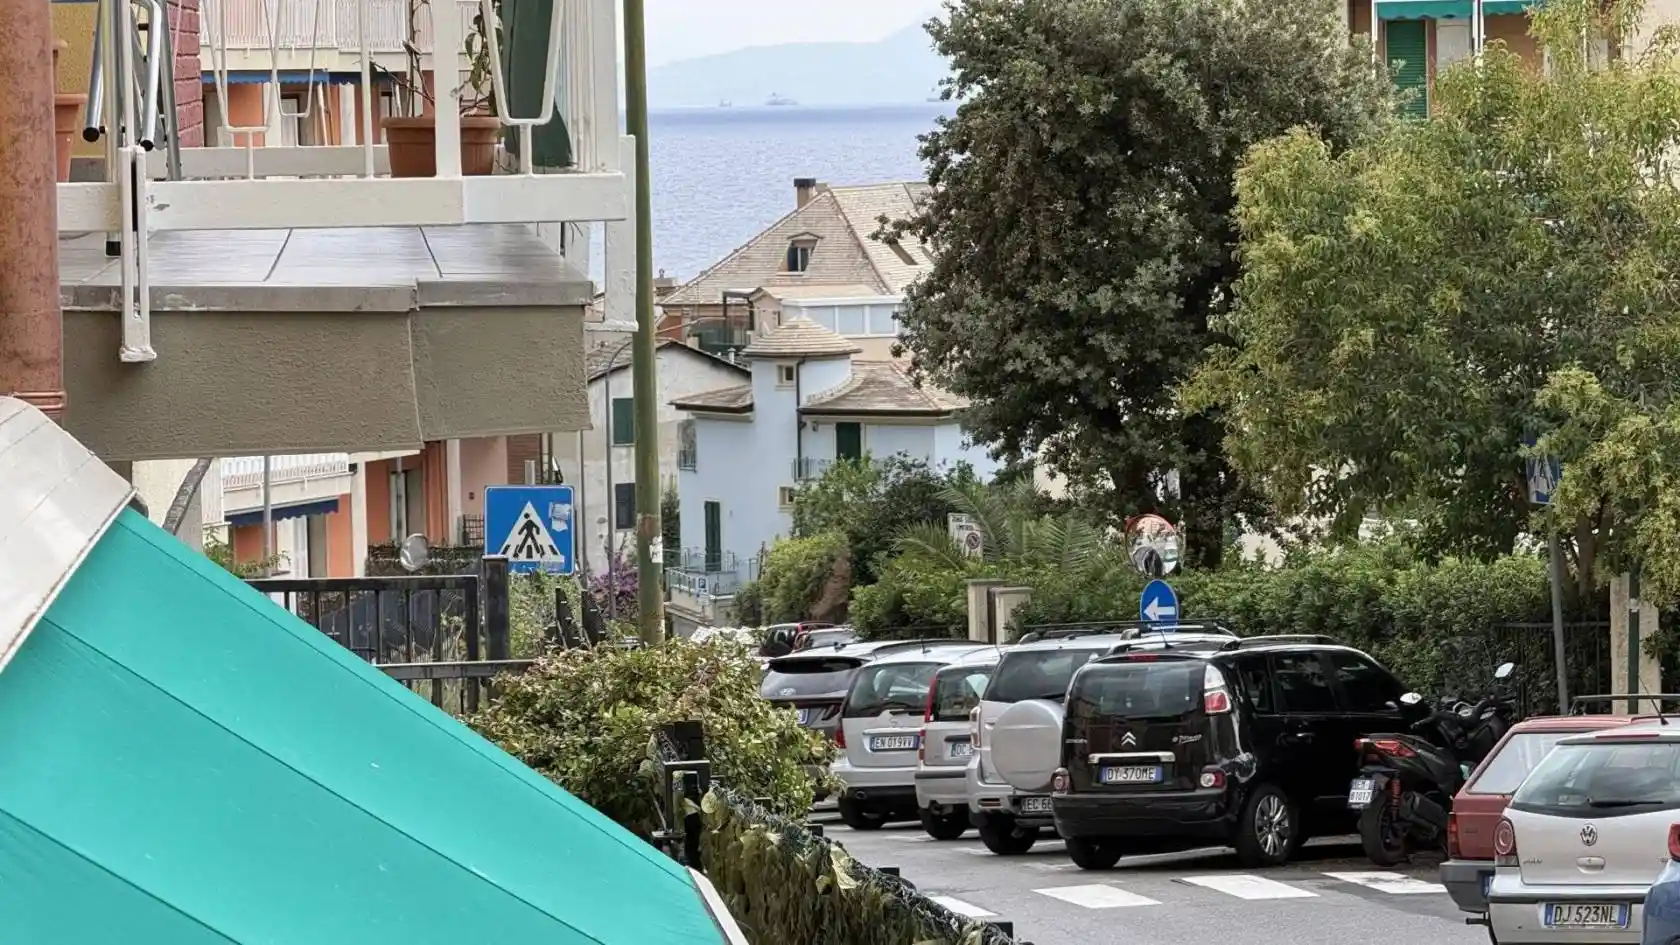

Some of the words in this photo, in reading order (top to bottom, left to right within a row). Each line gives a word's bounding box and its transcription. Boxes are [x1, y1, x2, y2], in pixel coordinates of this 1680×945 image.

[1107, 767, 1119, 780] DY
[1123, 767, 1154, 780] 370ME
[1554, 905, 1571, 923] DJ
[1574, 905, 1616, 923] 523NL
